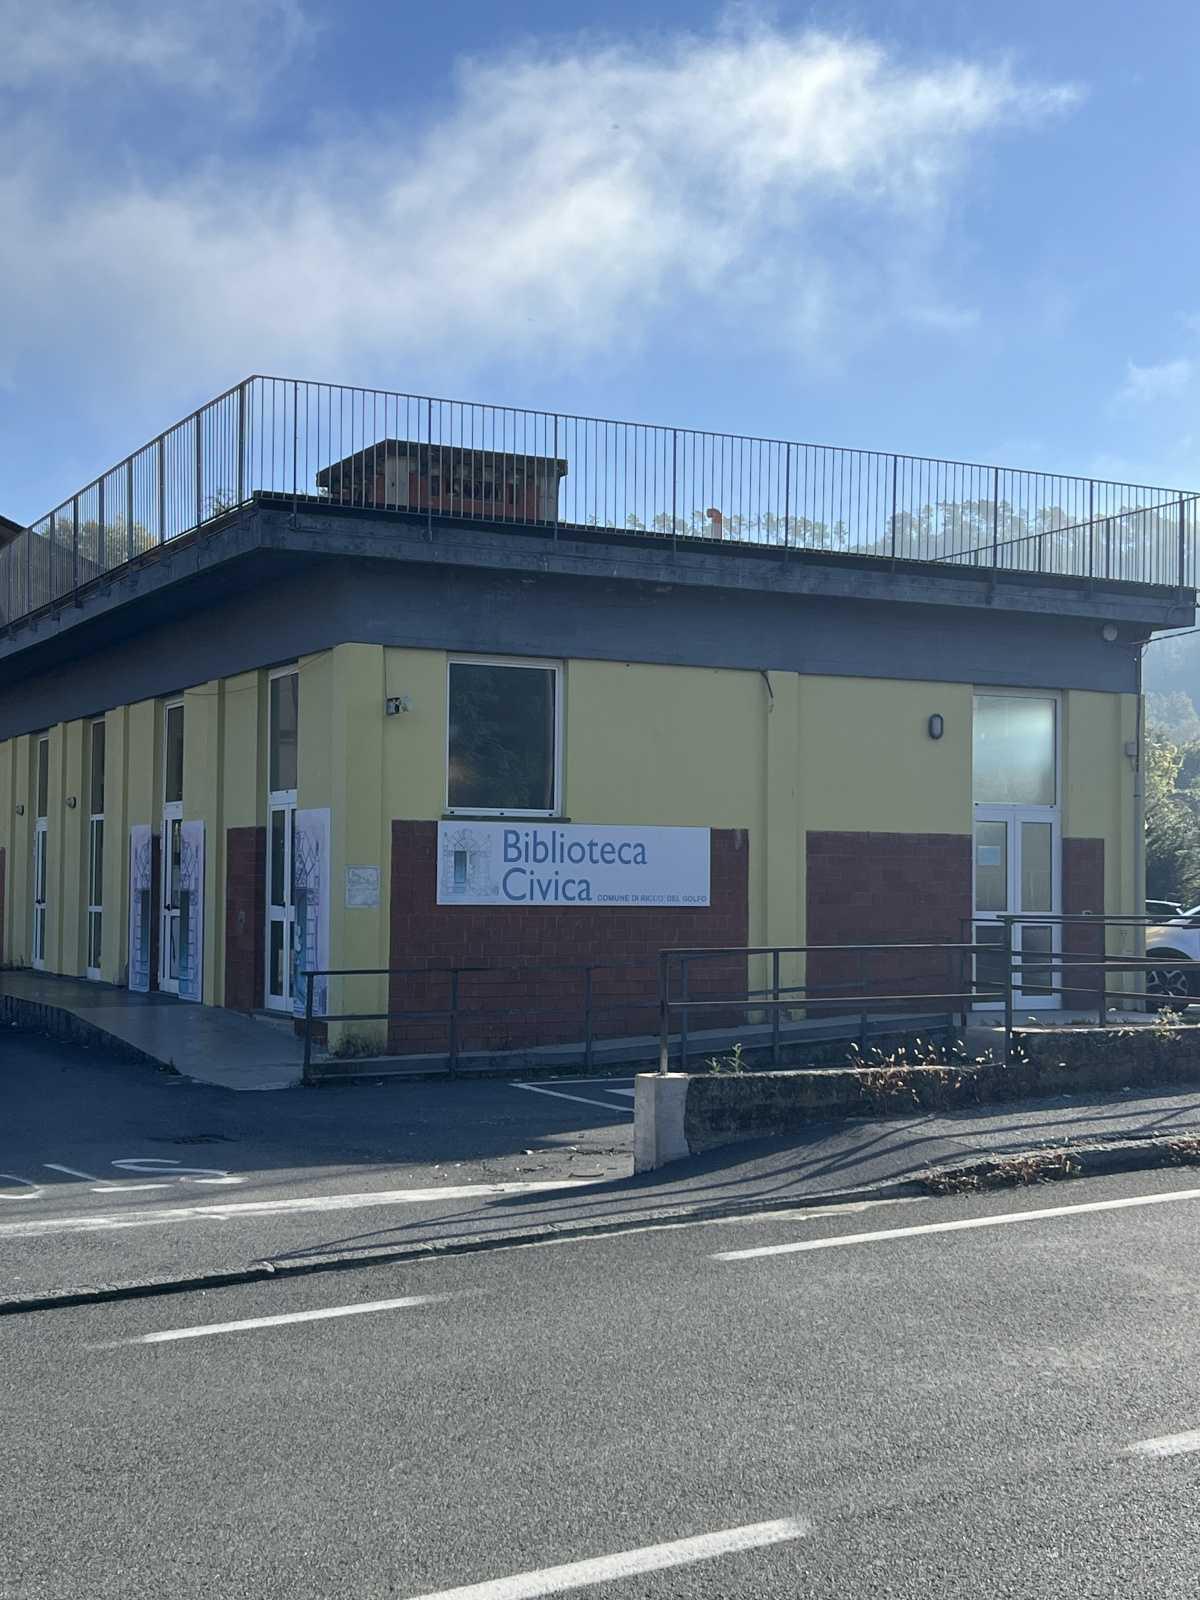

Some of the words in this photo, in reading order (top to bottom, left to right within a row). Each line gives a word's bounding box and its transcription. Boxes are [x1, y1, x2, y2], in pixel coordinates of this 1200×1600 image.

[503, 830, 647, 865] Biblioteca
[502, 867, 593, 901] Civica
[597, 894, 630, 903] COMUNE
[631, 894, 639, 903] DI
[667, 894, 681, 903] DEL
[682, 895, 707, 904] GOLFO
